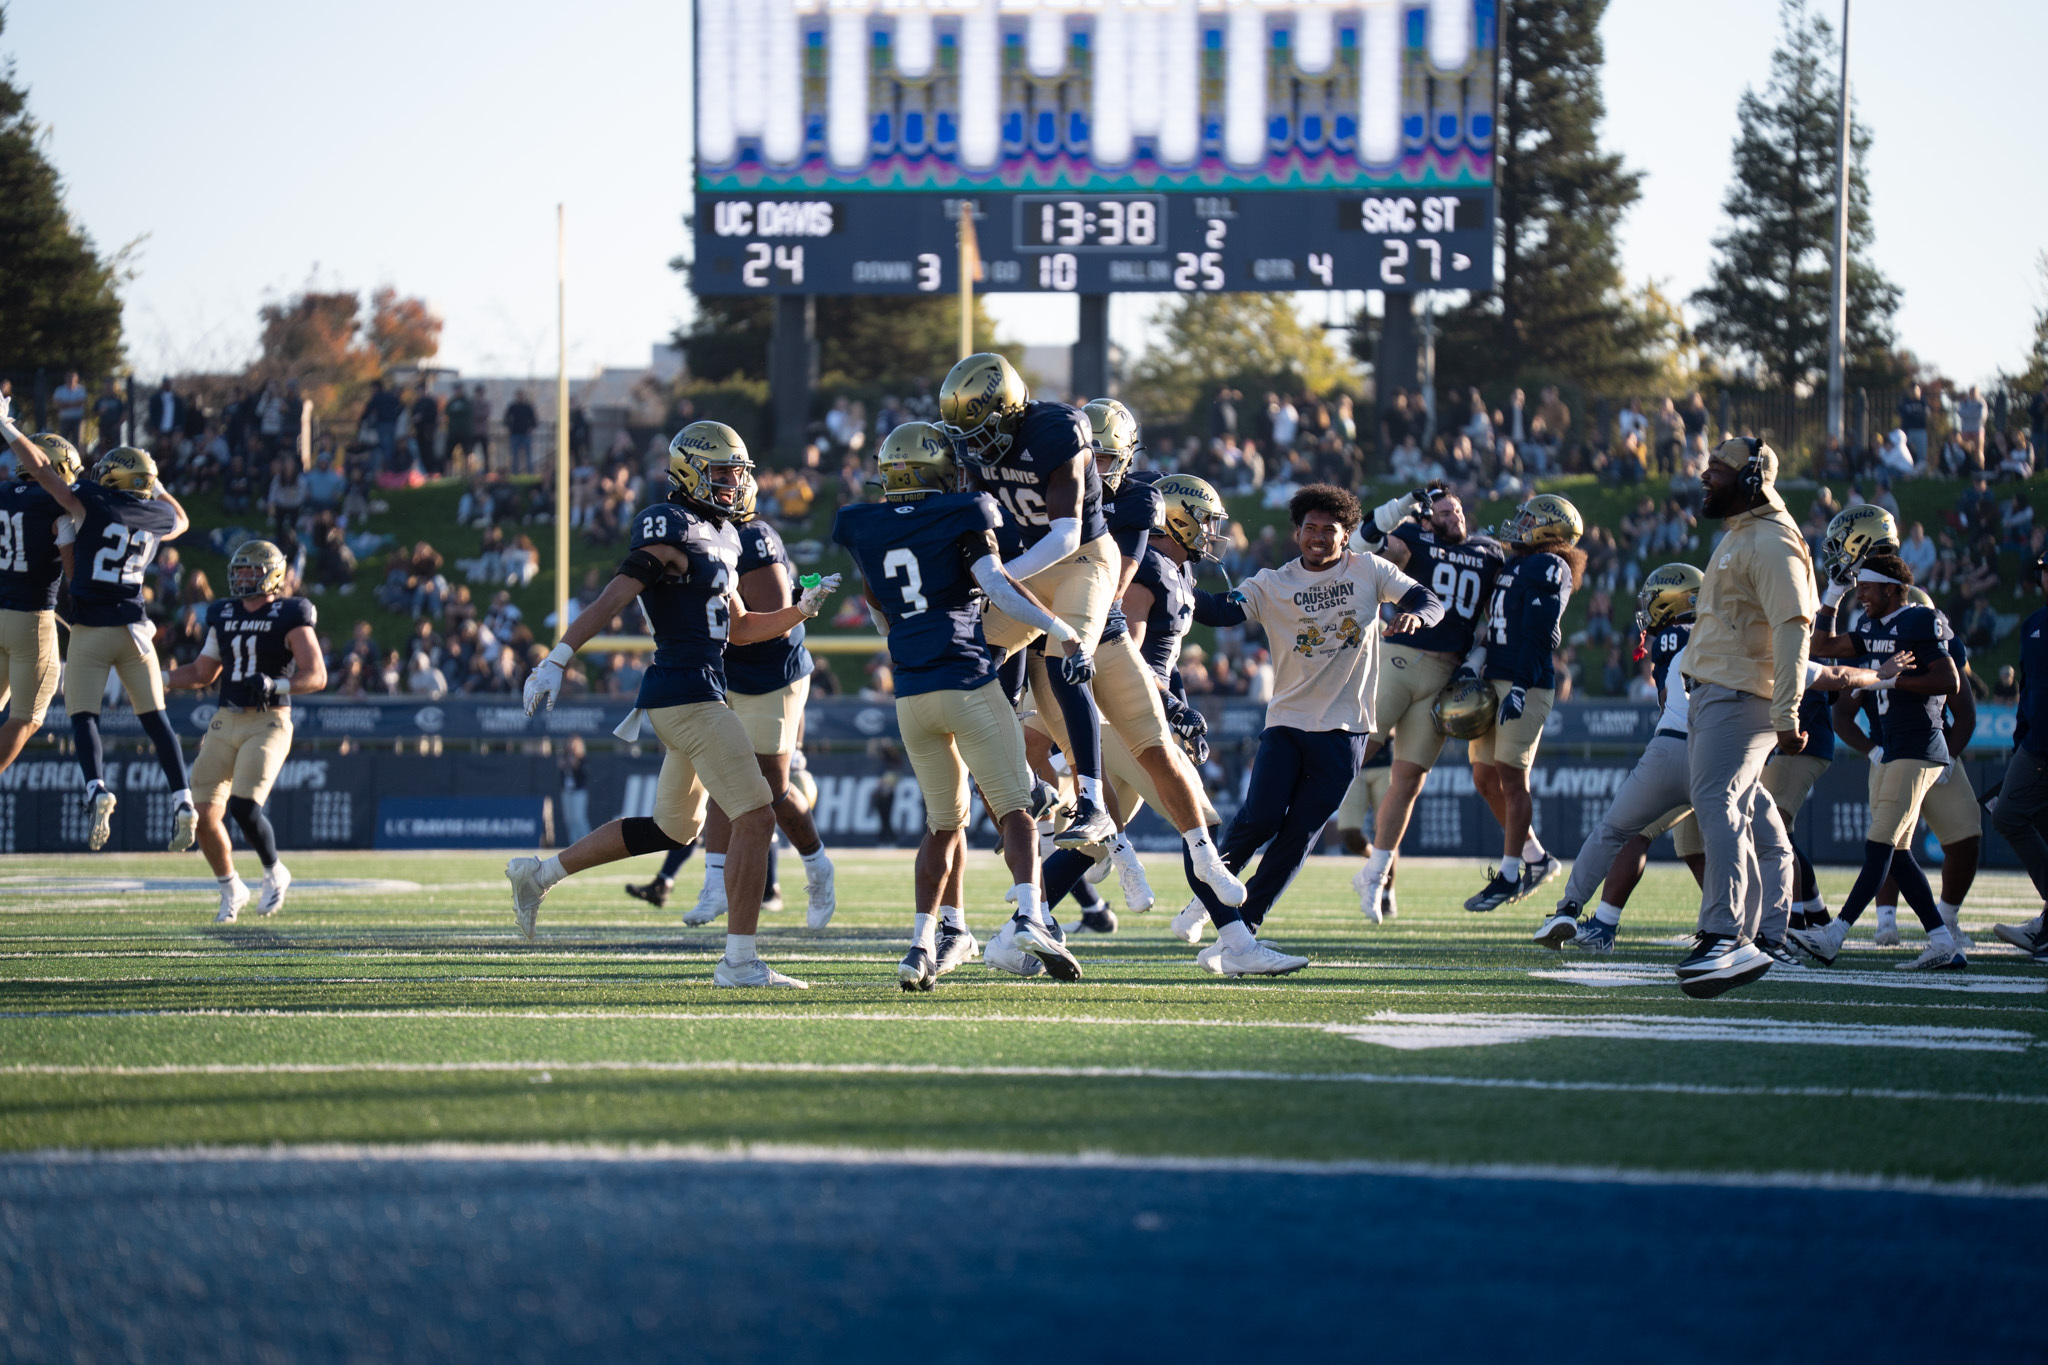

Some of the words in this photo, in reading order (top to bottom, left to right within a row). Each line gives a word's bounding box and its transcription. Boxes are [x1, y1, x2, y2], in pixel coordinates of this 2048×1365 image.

[714, 201, 752, 236] UC
[757, 201, 833, 236] DAVIS
[1041, 201, 1156, 246] 13:38
[1362, 197, 1416, 233] SAC
[1421, 196, 1461, 232] ST
[1206, 219, 1226, 249] 2
[743, 242, 804, 287] 24
[853, 261, 912, 283] DOWN
[917, 253, 941, 291] 3
[1040, 253, 1077, 291] 10
[1174, 252, 1225, 290] 25
[1253, 259, 1295, 282] QTR
[1309, 253, 1333, 286] 4
[1380, 239, 1441, 284] 27
[966, 371, 1004, 418] Davis
[671, 431, 710, 450] Davis
[904, 473, 911, 485] 3
[981, 466, 999, 480] UC
[1001, 467, 1041, 484] DAVIS
[904, 492, 926, 502] PRIDE
[1162, 482, 1210, 501] Davis
[998, 486, 1050, 527] 16
[1834, 508, 1875, 530] Davis
[643, 515, 667, 539] 23
[92, 522, 154, 585] 22
[755, 537, 777, 560] 92
[1429, 546, 1445, 559] UC
[1448, 552, 1484, 569] DAVIS
[883, 547, 928, 620] 3
[1545, 564, 1563, 585] 44
[1293, 582, 1355, 606] CAUSEWAY
[1432, 562, 1481, 620] 90
[1304, 597, 1347, 613] CLASSIC
[224, 621, 239, 632] UC
[240, 621, 273, 632] DAVIS
[1934, 618, 1943, 637] 6
[1660, 633, 1678, 652] 99
[1872, 639, 1896, 653] DAVIS
[231, 635, 257, 682] 11
